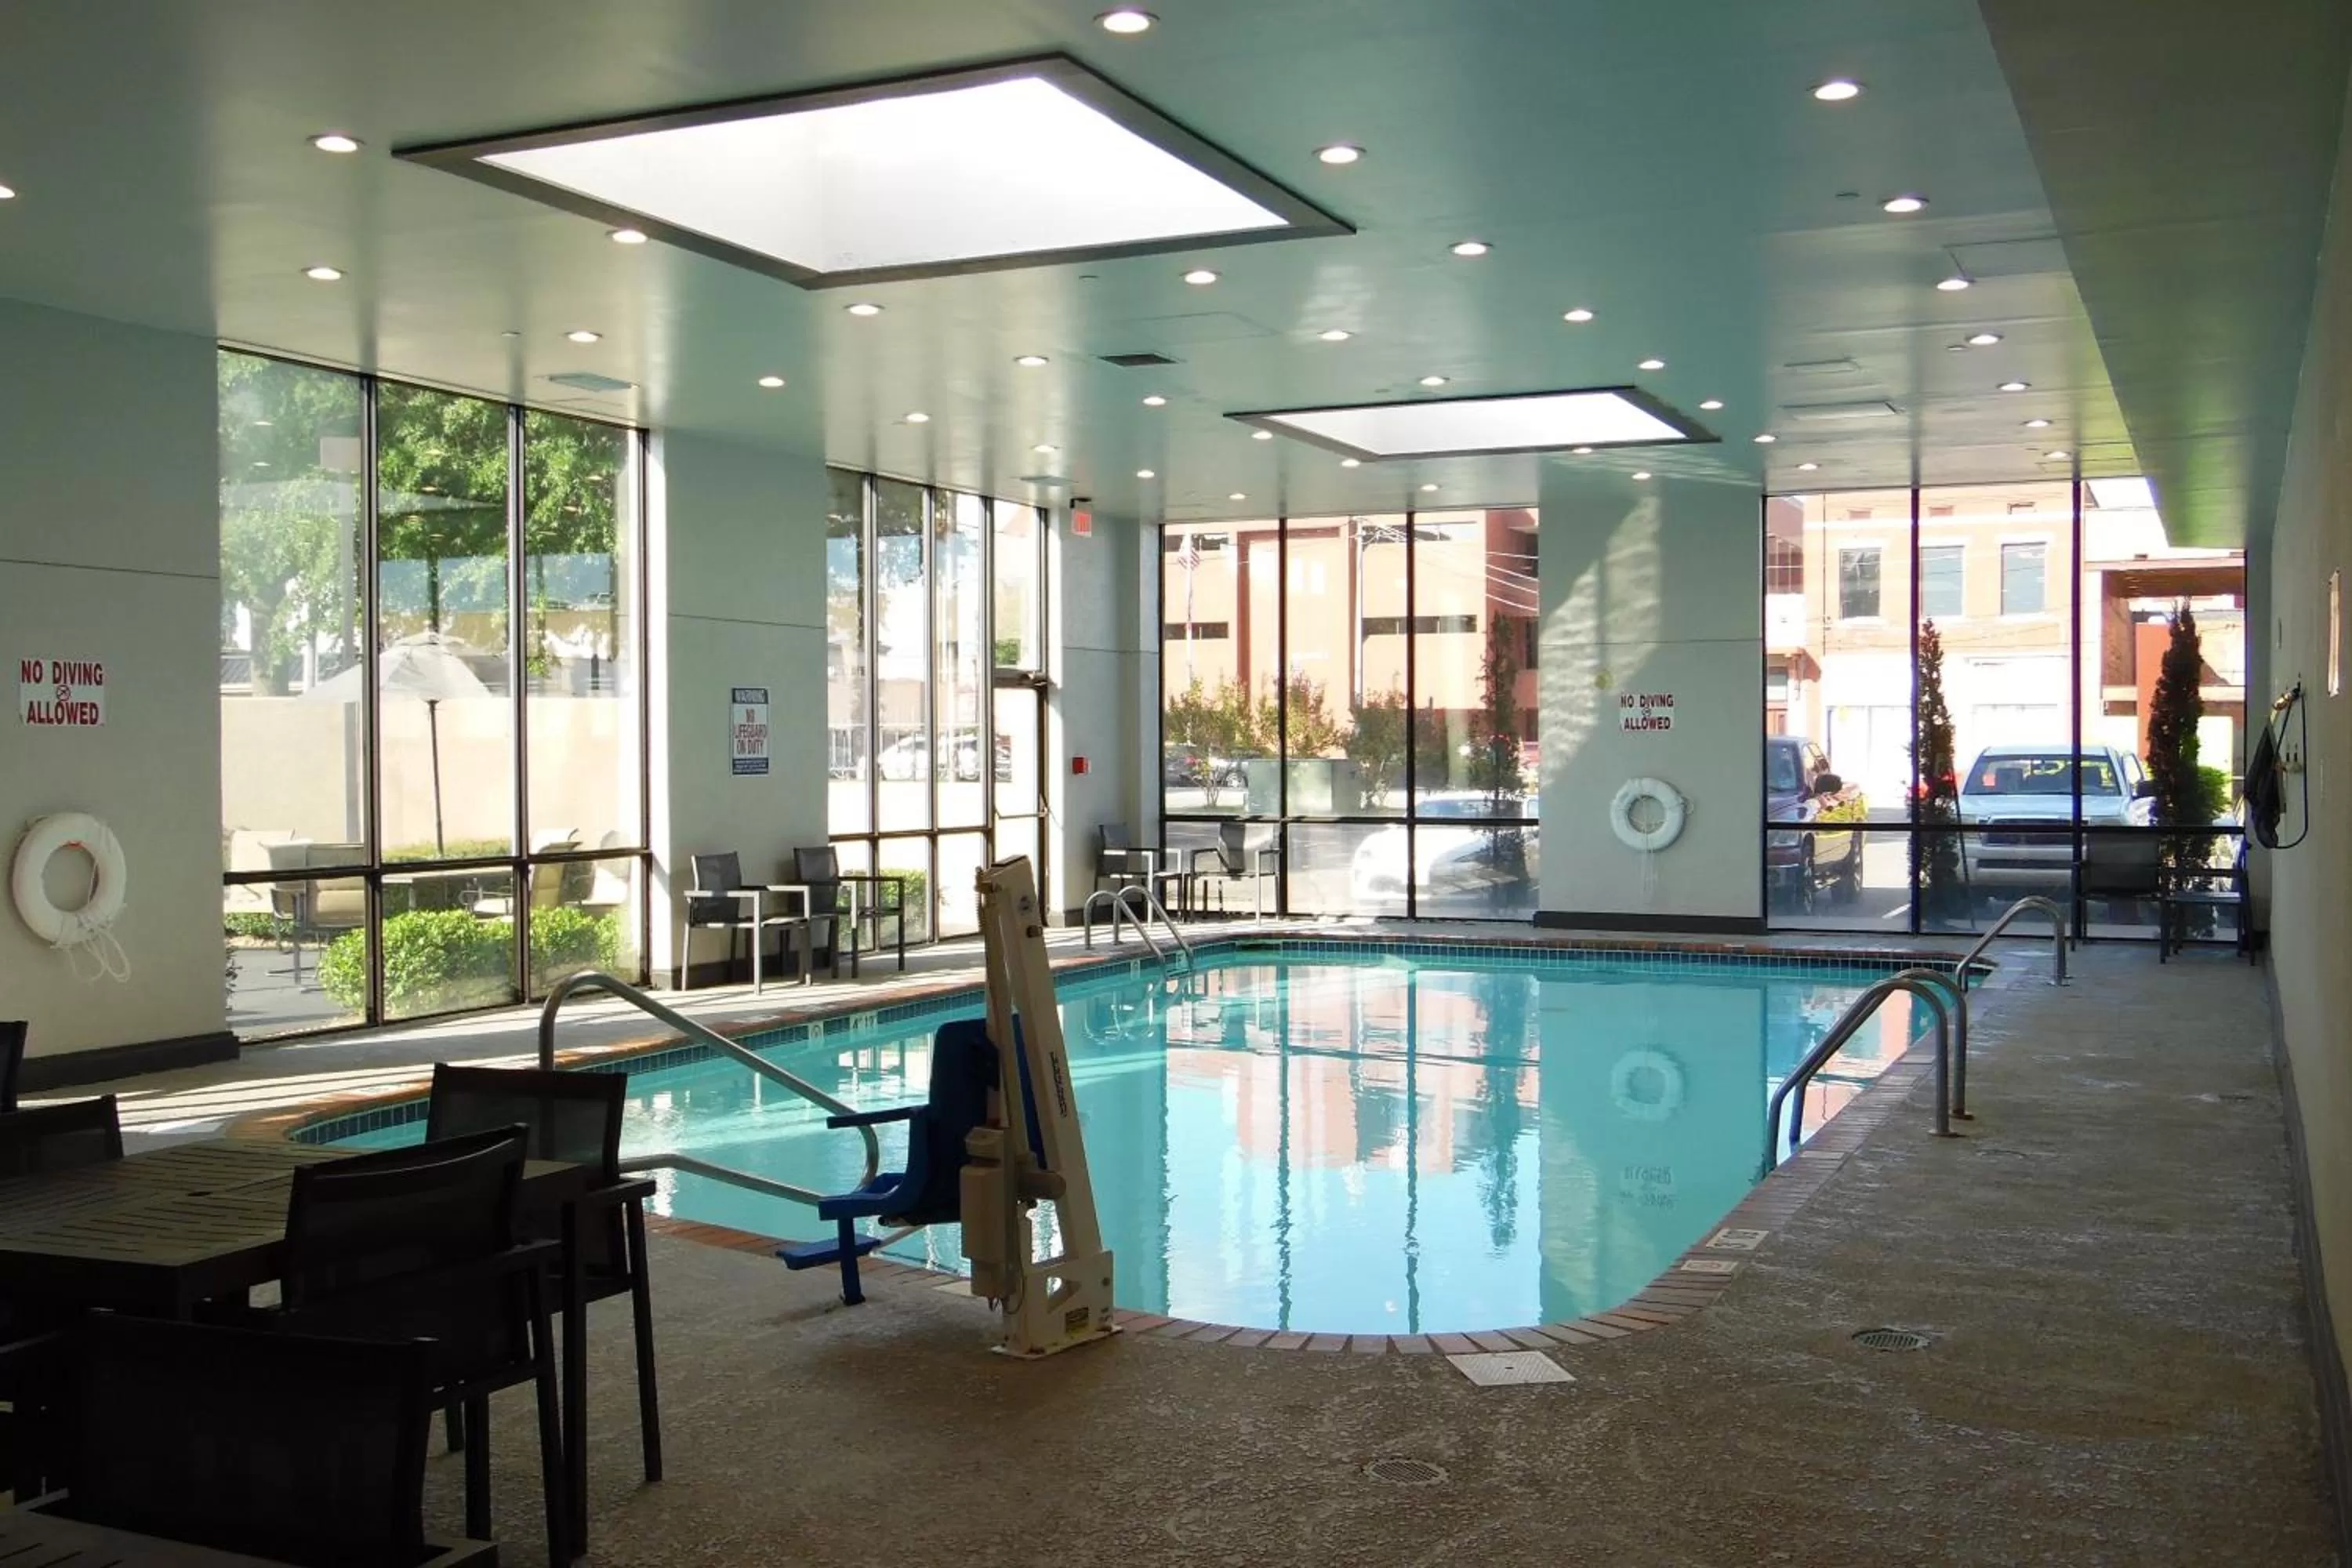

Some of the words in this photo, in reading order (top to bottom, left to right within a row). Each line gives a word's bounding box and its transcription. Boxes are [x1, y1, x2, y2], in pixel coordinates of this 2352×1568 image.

[21, 659, 43, 684] NO
[52, 661, 103, 685] DIVING
[1621, 695, 1634, 708] NO
[1639, 694, 1674, 707] DIVING
[27, 700, 99, 725] ALLOWED
[1624, 717, 1671, 730] ALLOWED
